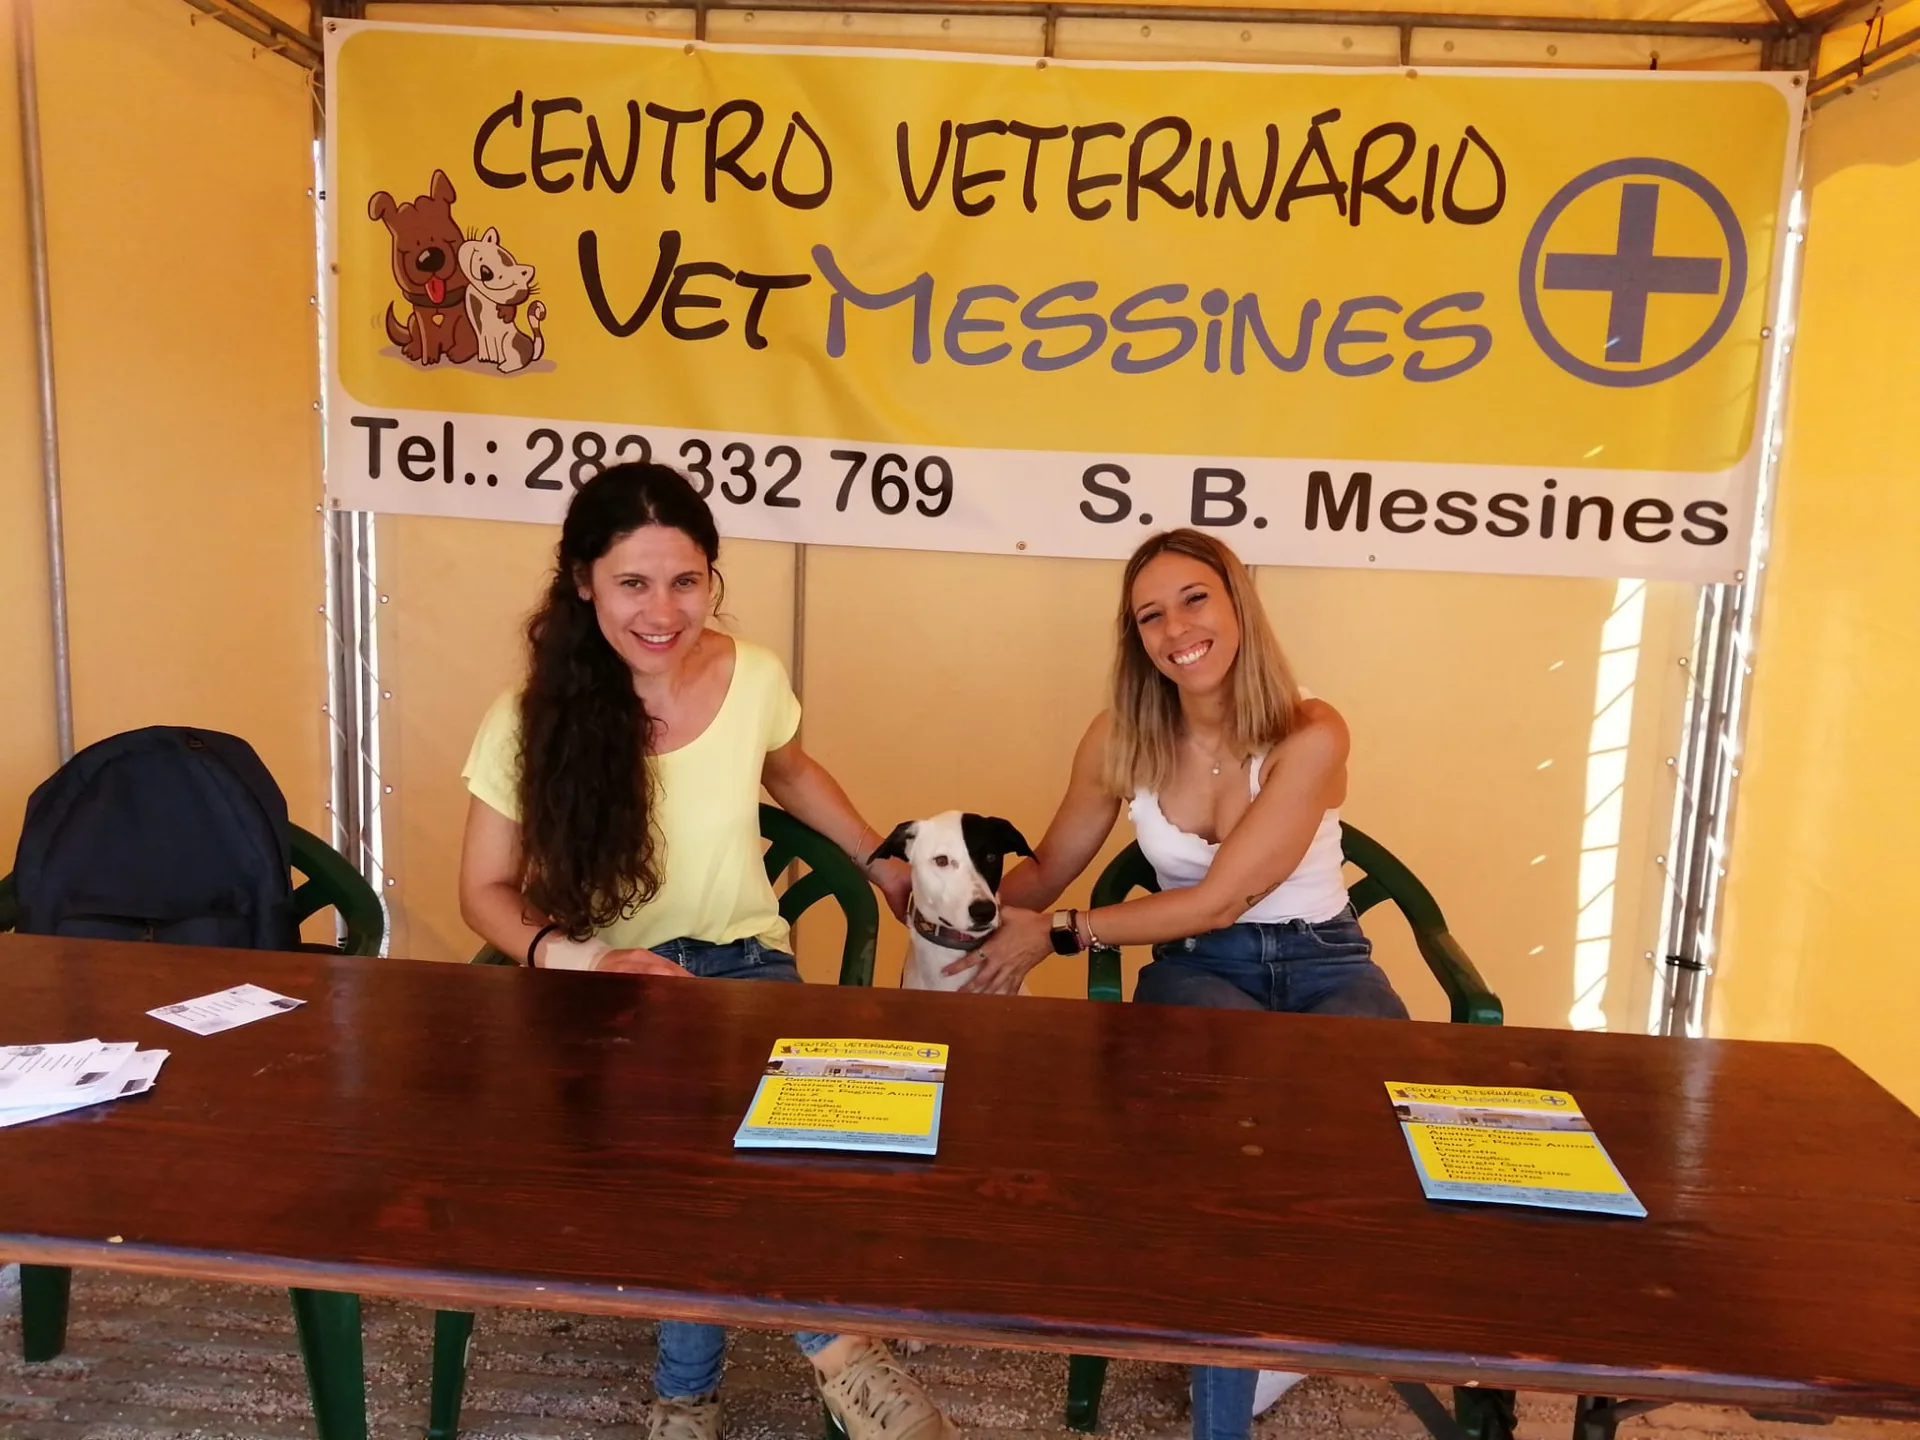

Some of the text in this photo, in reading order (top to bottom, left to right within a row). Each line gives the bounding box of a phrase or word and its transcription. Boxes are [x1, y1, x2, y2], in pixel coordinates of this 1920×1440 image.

[473, 90, 1507, 227] CENTRO VETERINÁRIO
[351, 416, 499, 488] Tel.:
[679, 439, 801, 508] 332
[829, 450, 953, 518] 769
[1079, 463, 1730, 546] S. B. Messines
